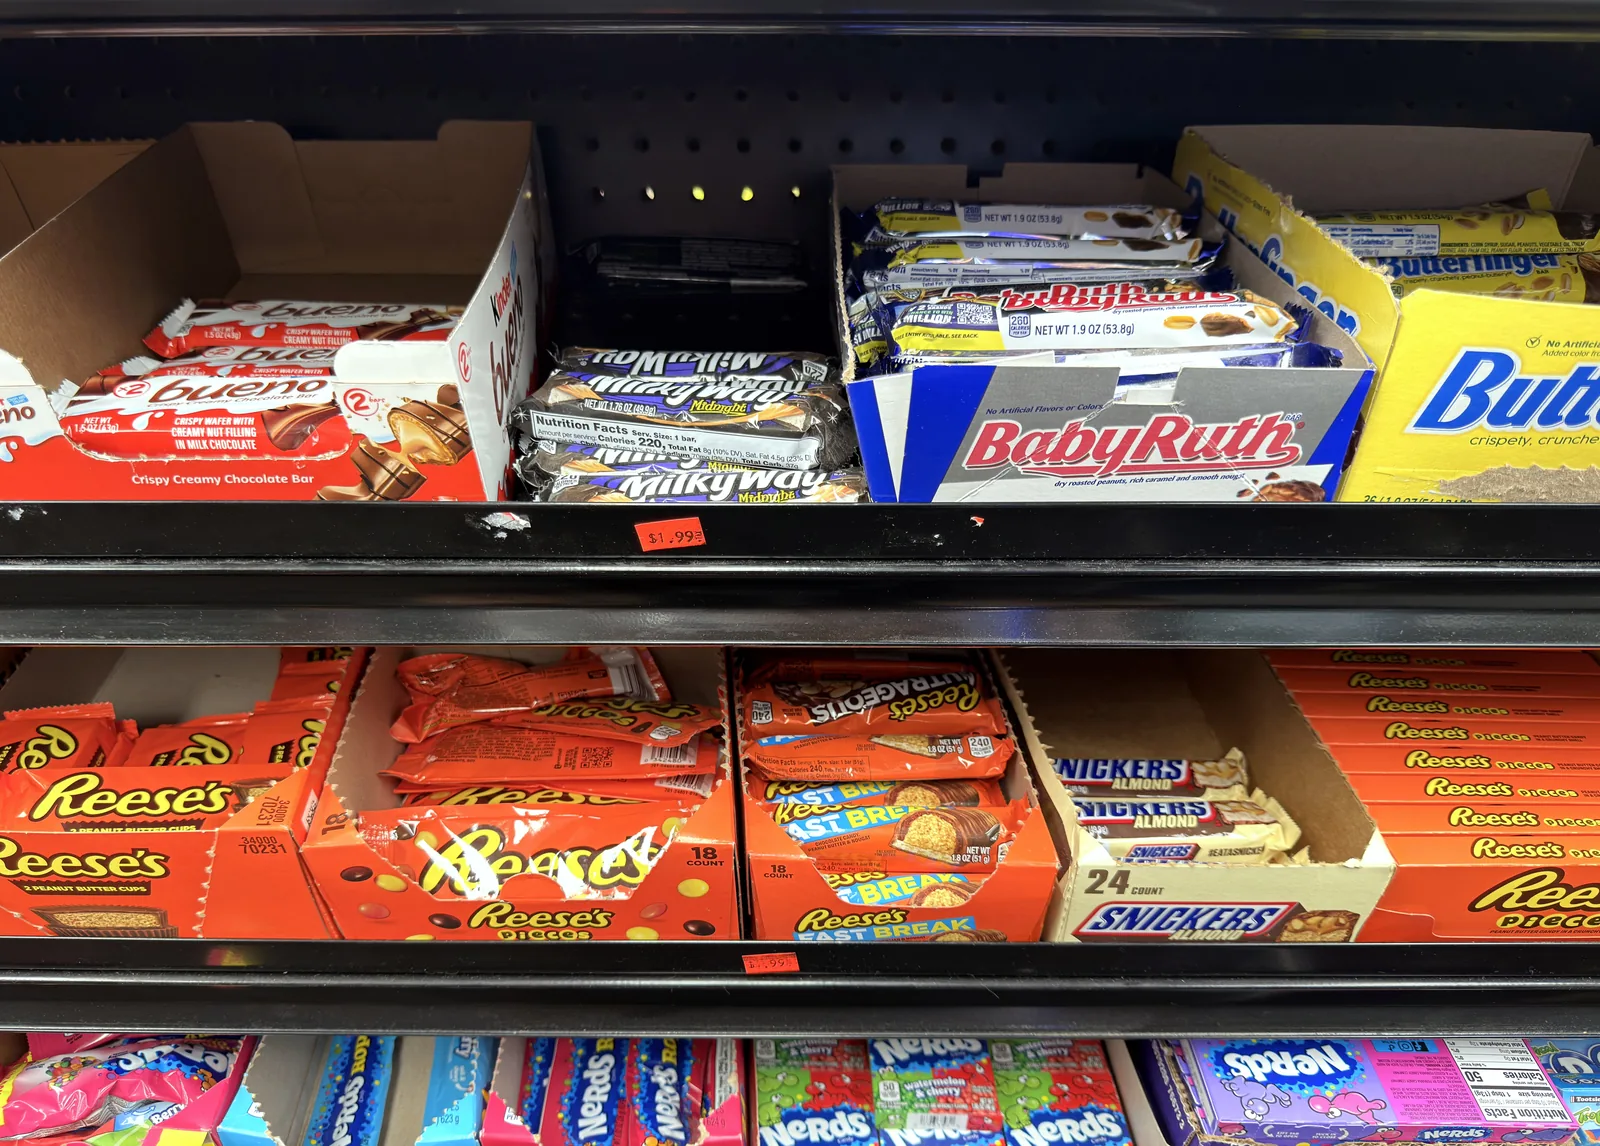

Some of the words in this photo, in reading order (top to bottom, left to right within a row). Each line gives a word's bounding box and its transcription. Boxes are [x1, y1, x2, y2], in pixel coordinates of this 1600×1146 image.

[984, 214, 1000, 222] NET
[1000, 214, 1013, 222] WT
[1014, 214, 1025, 223] 1.9
[1026, 214, 1036, 223] OZ
[1037, 215, 1063, 225] (53.8g)
[261, 303, 406, 319] bueno
[1011, 315, 1029, 326] 260
[286, 328, 309, 336] CRISPY
[310, 328, 335, 336] WAFER
[336, 328, 352, 336] WITH
[1035, 325, 1054, 336] NET
[1055, 325, 1070, 336] WT
[1072, 324, 1086, 335] 1.9
[1088, 324, 1101, 335] OZ
[1102, 323, 1135, 336] (53.8g)
[283, 336, 311, 345] CREAMY
[312, 336, 326, 345] NUT
[1546, 340, 1561, 348] No
[490, 276, 523, 427] bueno
[1542, 349, 1569, 357] Added
[1569, 349, 1590, 357] color
[253, 367, 275, 375] CRISPY
[276, 367, 302, 375] WAFER
[304, 367, 324, 375] WITH
[149, 379, 329, 403] bueno
[349, 392, 369, 412] 2
[584, 398, 596, 409] NET
[609, 401, 623, 411] 1.76
[623, 402, 632, 413] OZ
[633, 403, 657, 417] (49.9g)
[690, 400, 747, 413] Midnight
[999, 406, 1034, 415] Artificial
[1034, 405, 1064, 413] Flavors
[1077, 403, 1104, 412] Colors
[83, 417, 99, 425] NET
[99, 417, 112, 425] WT
[174, 417, 203, 426] CRISPY
[204, 417, 231, 426] WAFER
[232, 417, 255, 426] WITH
[171, 427, 205, 438] CREAMY
[206, 427, 224, 438] NUT
[224, 427, 257, 438] FILLING
[536, 415, 590, 431] Nutrition
[594, 422, 629, 435] Facts
[632, 429, 651, 438] Serv.
[653, 432, 673, 441] Size:
[681, 435, 697, 443] bar,
[175, 439, 186, 450] IN
[189, 439, 209, 450] MILK
[209, 439, 257, 450] CHOCOLATE
[537, 428, 561, 438] Amount
[597, 434, 636, 446] Calories
[638, 437, 666, 451] 220,
[668, 443, 687, 452] Total
[688, 445, 702, 454] Fat
[770, 453, 786, 463] 4.5g
[1469, 435, 1533, 447] crispety,
[131, 475, 170, 486] Crispy
[173, 474, 222, 486] Creamy
[224, 474, 288, 485] Chocolate
[291, 474, 315, 485] Bar
[1054, 480, 1067, 488] dry
[1067, 479, 1096, 487] roasted
[1096, 477, 1128, 487] peanuts,
[1129, 476, 1144, 484] rich
[1145, 475, 1175, 484] caramel
[1175, 474, 1190, 482] and
[1191, 473, 1219, 481] smooth
[738, 489, 796, 503] Midnight
[648, 530, 694, 544] $1.99
[1350, 673, 1429, 689] Reese's
[889, 683, 982, 722] Reese's
[1368, 696, 1449, 713] Reese's
[1386, 722, 1469, 740] Reese's
[939, 738, 950, 746] NET
[951, 738, 962, 746] WT
[970, 737, 990, 747] 240
[1406, 750, 1491, 768] Reese's
[1054, 759, 1183, 782] NICKERS
[1111, 778, 1173, 791] ALMOND
[1426, 777, 1514, 797] Reese's
[30, 772, 232, 821] Reese's
[256, 795, 280, 826] 70231
[273, 799, 291, 823] 34000
[1449, 807, 1539, 827] Reese's
[321, 811, 349, 836] 18
[1133, 814, 1198, 829] ALMOND
[241, 836, 278, 845] 34000
[814, 836, 844, 847] CHOCOLATE
[238, 844, 287, 854] 70231
[691, 846, 718, 860] 18
[808, 844, 828, 852] PEANUT
[966, 846, 980, 854] NET
[980, 846, 991, 854] WT
[1129, 845, 1191, 859] SNICKERS
[1472, 837, 1564, 859] Reese's
[951, 854, 961, 863] 1.8
[962, 854, 972, 863] OZ
[972, 854, 982, 863] (51
[770, 864, 787, 873] 18
[763, 872, 794, 880] COUNT
[1084, 869, 1131, 895] 24
[1131, 886, 1165, 895] COUNT
[468, 902, 614, 929] Reese's
[797, 909, 907, 933] Reese's
[1092, 906, 1283, 931] SNICKERS
[873, 918, 971, 939] BREAK
[1168, 929, 1246, 941] ALMOND
[800, 1045, 833, 1057] cherry
[1464, 1070, 1484, 1083] 50
[1502, 1071, 1544, 1082] Calories
[883, 1082, 895, 1091] 50
[903, 1076, 966, 1092] watermelon
[916, 1088, 924, 1098] &
[925, 1085, 961, 1099] cherry
[1533, 1091, 1556, 1099] Serving
[1484, 1107, 1516, 1118] Facts
[1518, 1108, 1569, 1120] Nutrition
[440, 1115, 455, 1125] 623
